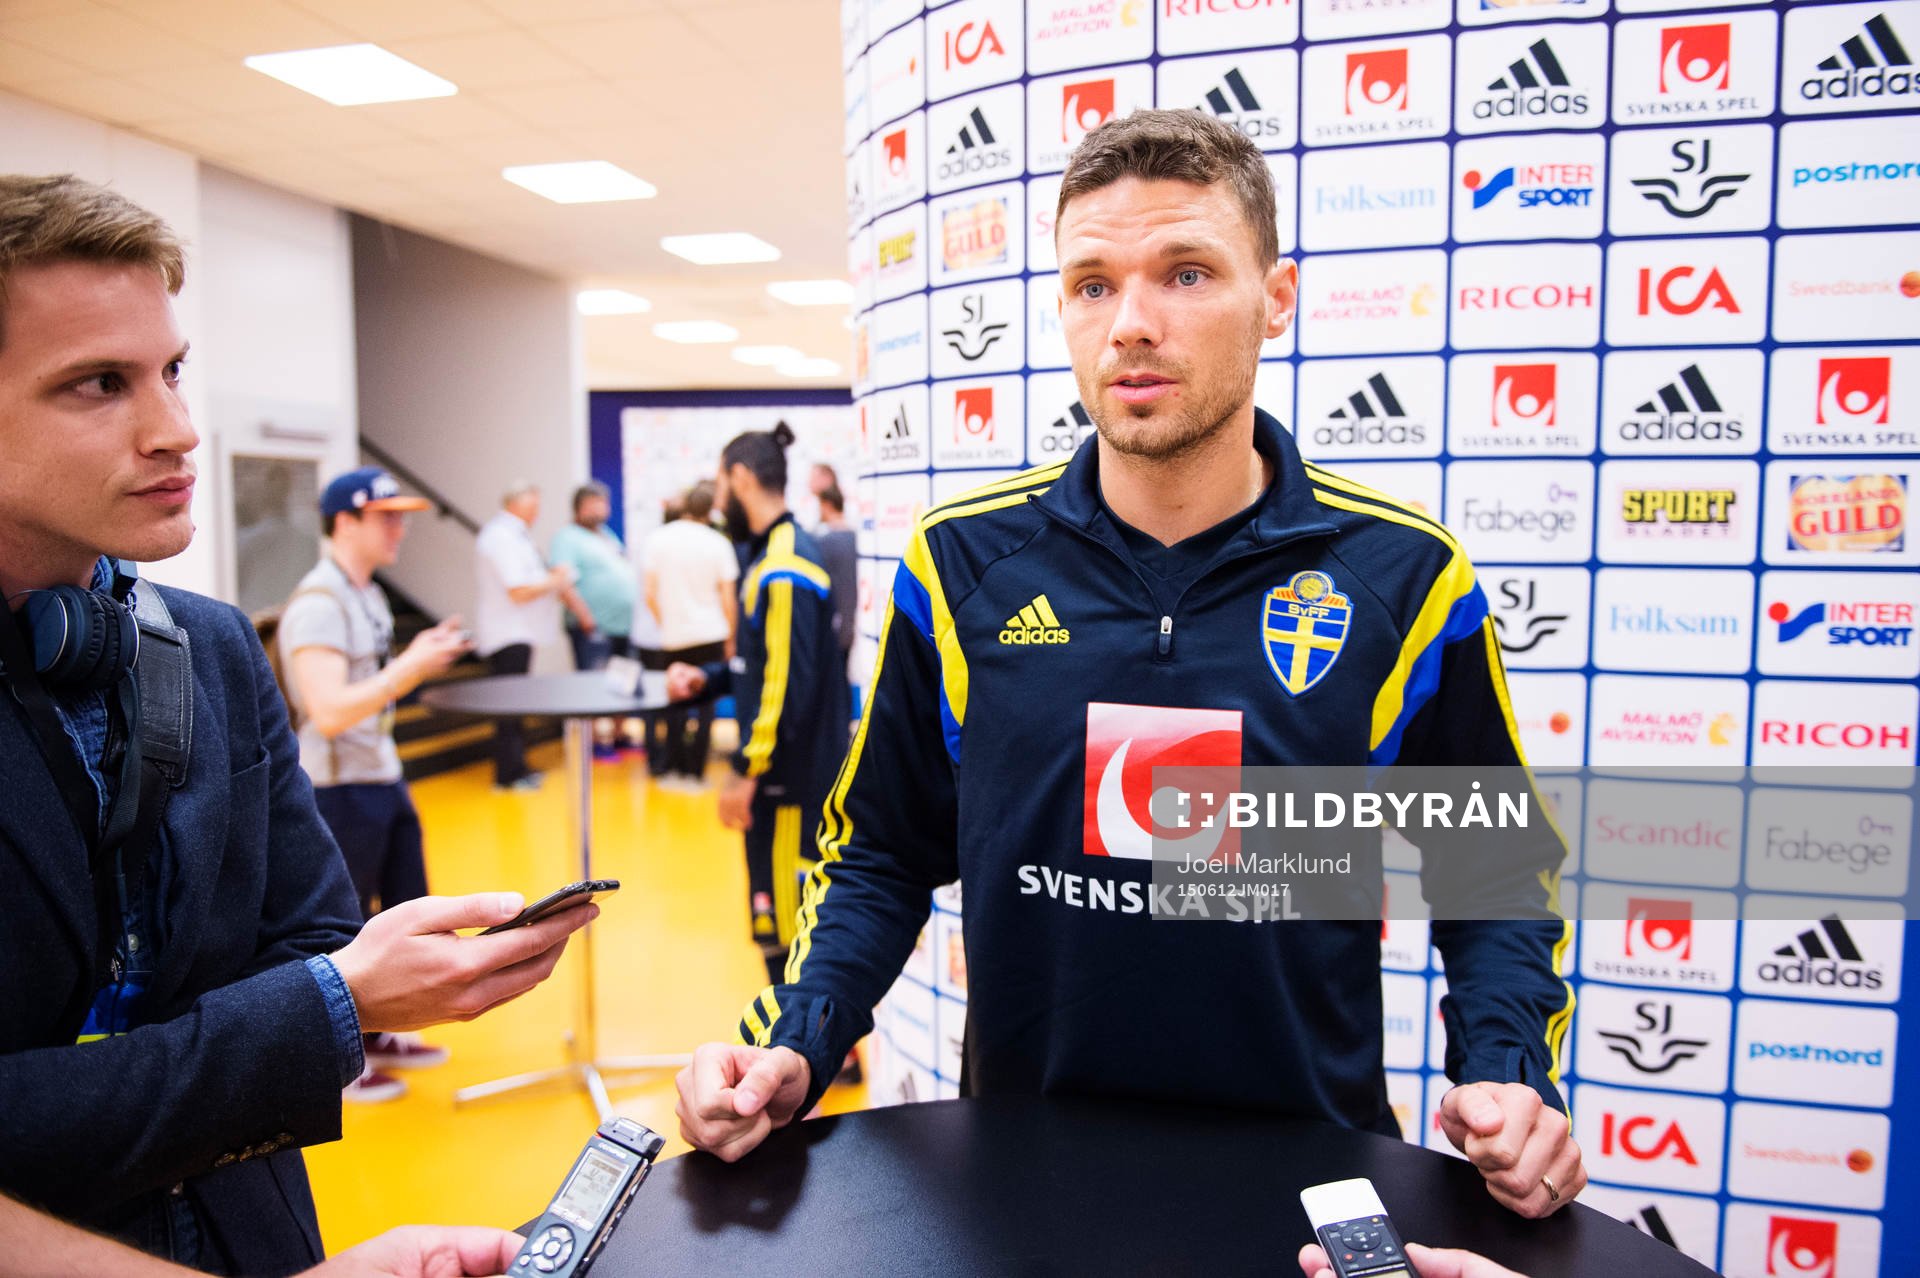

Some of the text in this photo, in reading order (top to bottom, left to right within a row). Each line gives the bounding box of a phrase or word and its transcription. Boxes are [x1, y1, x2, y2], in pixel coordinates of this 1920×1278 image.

[1165, 0, 1291, 18] RIC
[944, 20, 1006, 71] ICA
[1473, 88, 1589, 120] adidas
[1627, 97, 1760, 116] SVENSKA SPEL
[1671, 138, 1711, 175] SJ
[1519, 164, 1593, 185] INTER
[1793, 161, 1920, 187] postnor
[1315, 184, 1436, 215] Folksam
[1519, 188, 1594, 208] SPORT
[1459, 284, 1593, 311] RICOH
[1638, 265, 1741, 316] ICA
[1789, 280, 1895, 298] Swedbank
[962, 294, 984, 324] SJ
[1314, 416, 1427, 446] adidas
[1619, 412, 1743, 441] adidas
[1783, 432, 1919, 446] SVENSKA SPEL
[1463, 499, 1577, 541] Fabege
[1622, 489, 1736, 523] SPORT
[1793, 502, 1902, 537] GULD
[1626, 524, 1729, 536] BLADET
[1500, 579, 1537, 612] SJ
[1609, 605, 1739, 635] Folksam
[1829, 603, 1913, 624] INTER
[999, 625, 1070, 645] adidas
[1828, 627, 1914, 647] SPORT
[1622, 712, 1703, 726] MALMÖ
[1600, 728, 1699, 744] AVIATION
[1761, 720, 1911, 749] RICOH
[1596, 815, 1733, 851] Scandic
[1765, 825, 1893, 874] Fabege
[1017, 864, 1301, 924] SVENSKA SPEL
[1757, 957, 1883, 990] adidas
[1635, 1002, 1673, 1034] SJ
[1749, 1041, 1882, 1067] postnord
[1601, 1112, 1699, 1167] ICA
